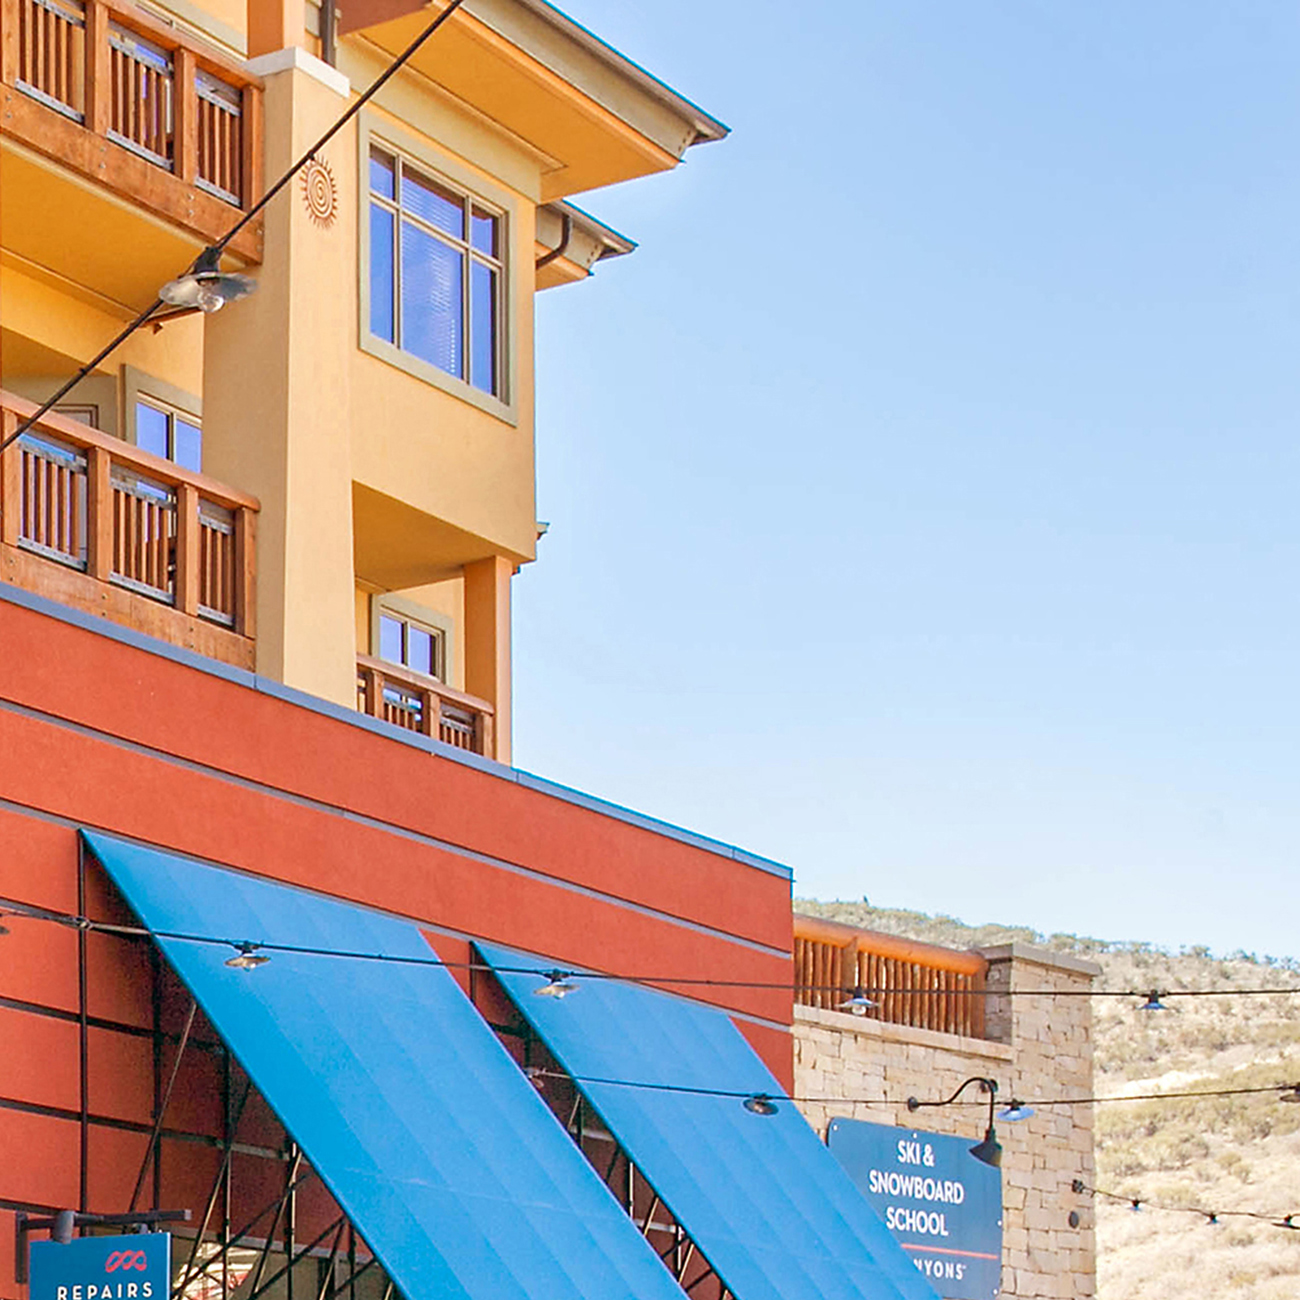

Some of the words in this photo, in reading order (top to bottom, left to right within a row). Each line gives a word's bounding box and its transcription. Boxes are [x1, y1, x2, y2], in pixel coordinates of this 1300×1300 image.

[897, 1140, 920, 1165] SKI
[922, 1143, 935, 1167] &
[869, 1169, 965, 1205] SNOWBOARD
[886, 1206, 949, 1236] SCHOOL
[57, 1282, 152, 1300] REPAIRS
